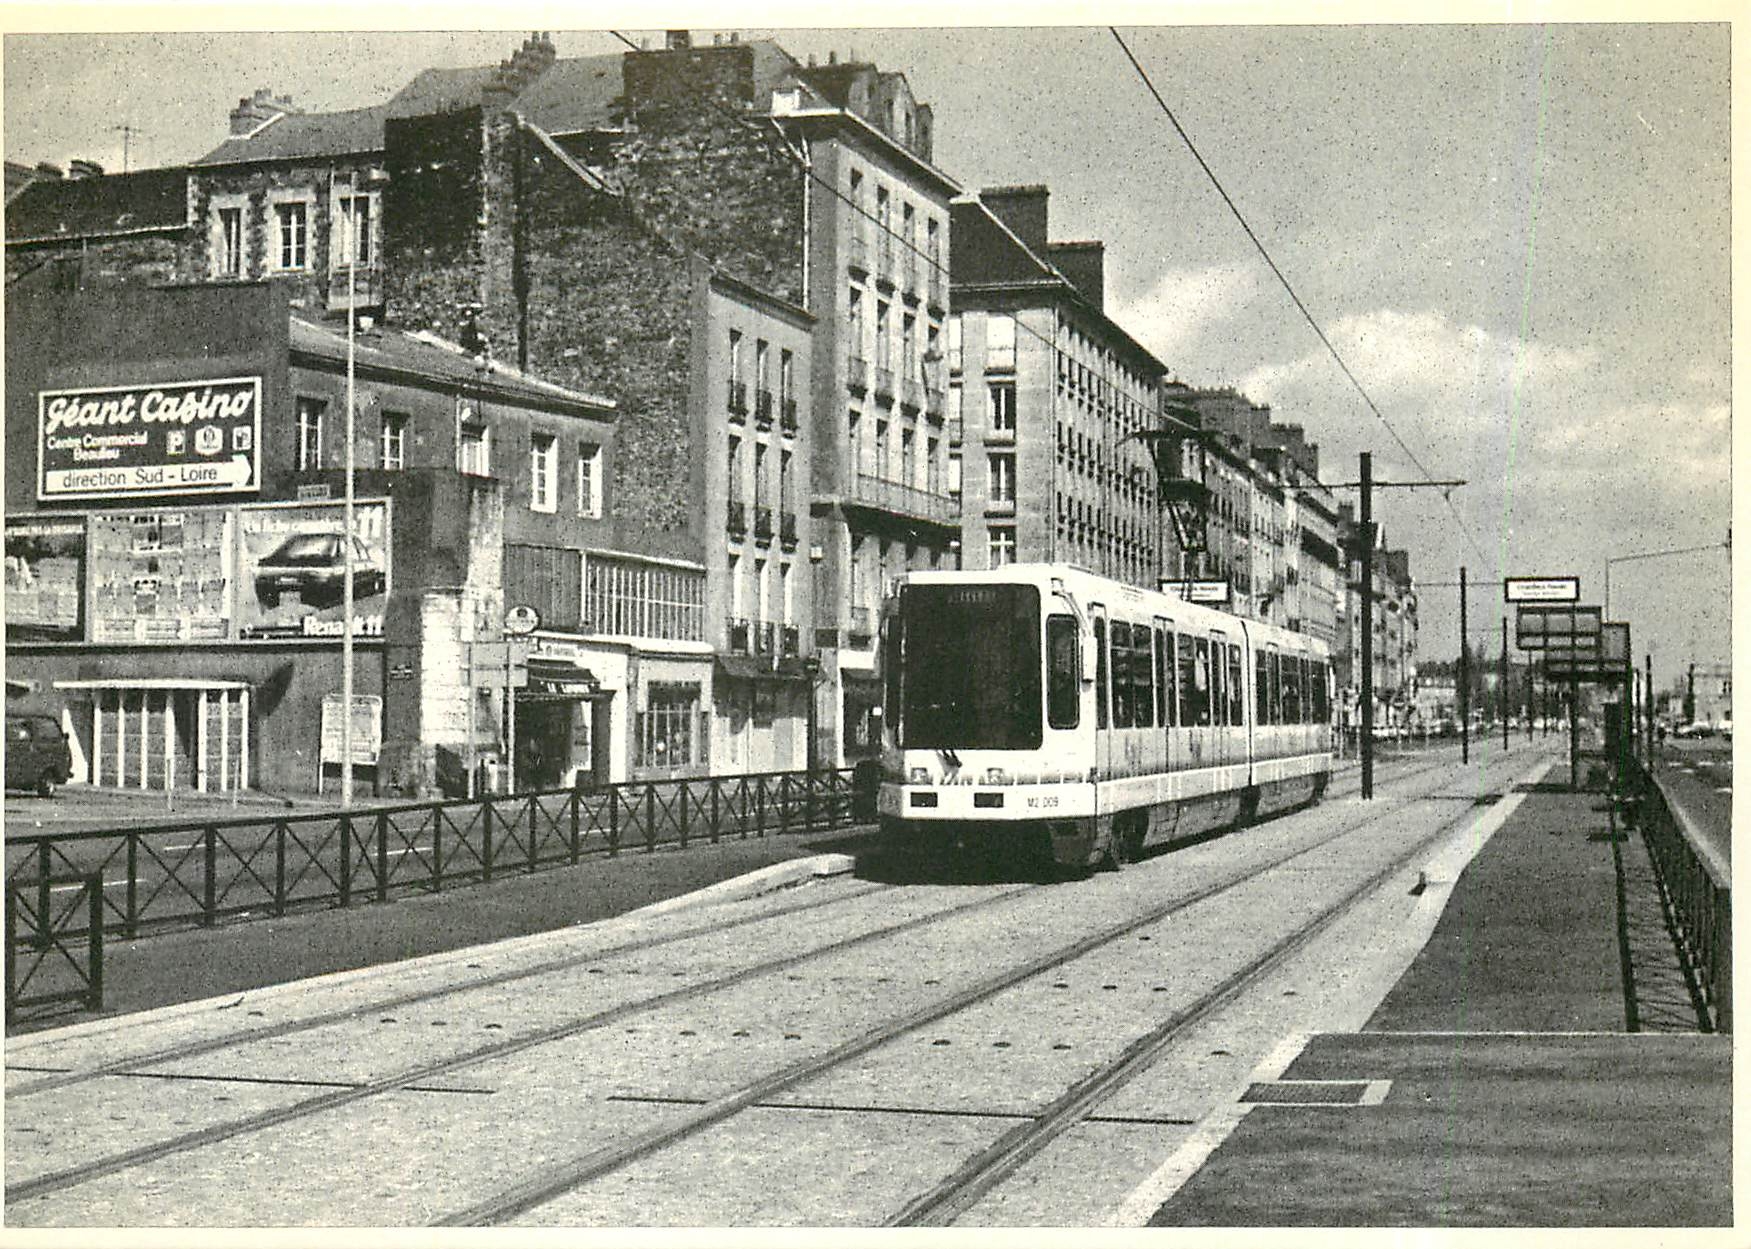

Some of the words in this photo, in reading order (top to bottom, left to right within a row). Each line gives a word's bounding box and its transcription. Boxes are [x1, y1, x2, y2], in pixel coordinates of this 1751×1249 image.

[46, 394, 136, 434] Géant
[140, 389, 254, 424] Casino
[83, 431, 148, 448] Commercial
[63, 471, 126, 488] direction
[135, 468, 163, 485] Sud
[180, 465, 218, 483] Loire
[304, 615, 364, 636] Renalt
